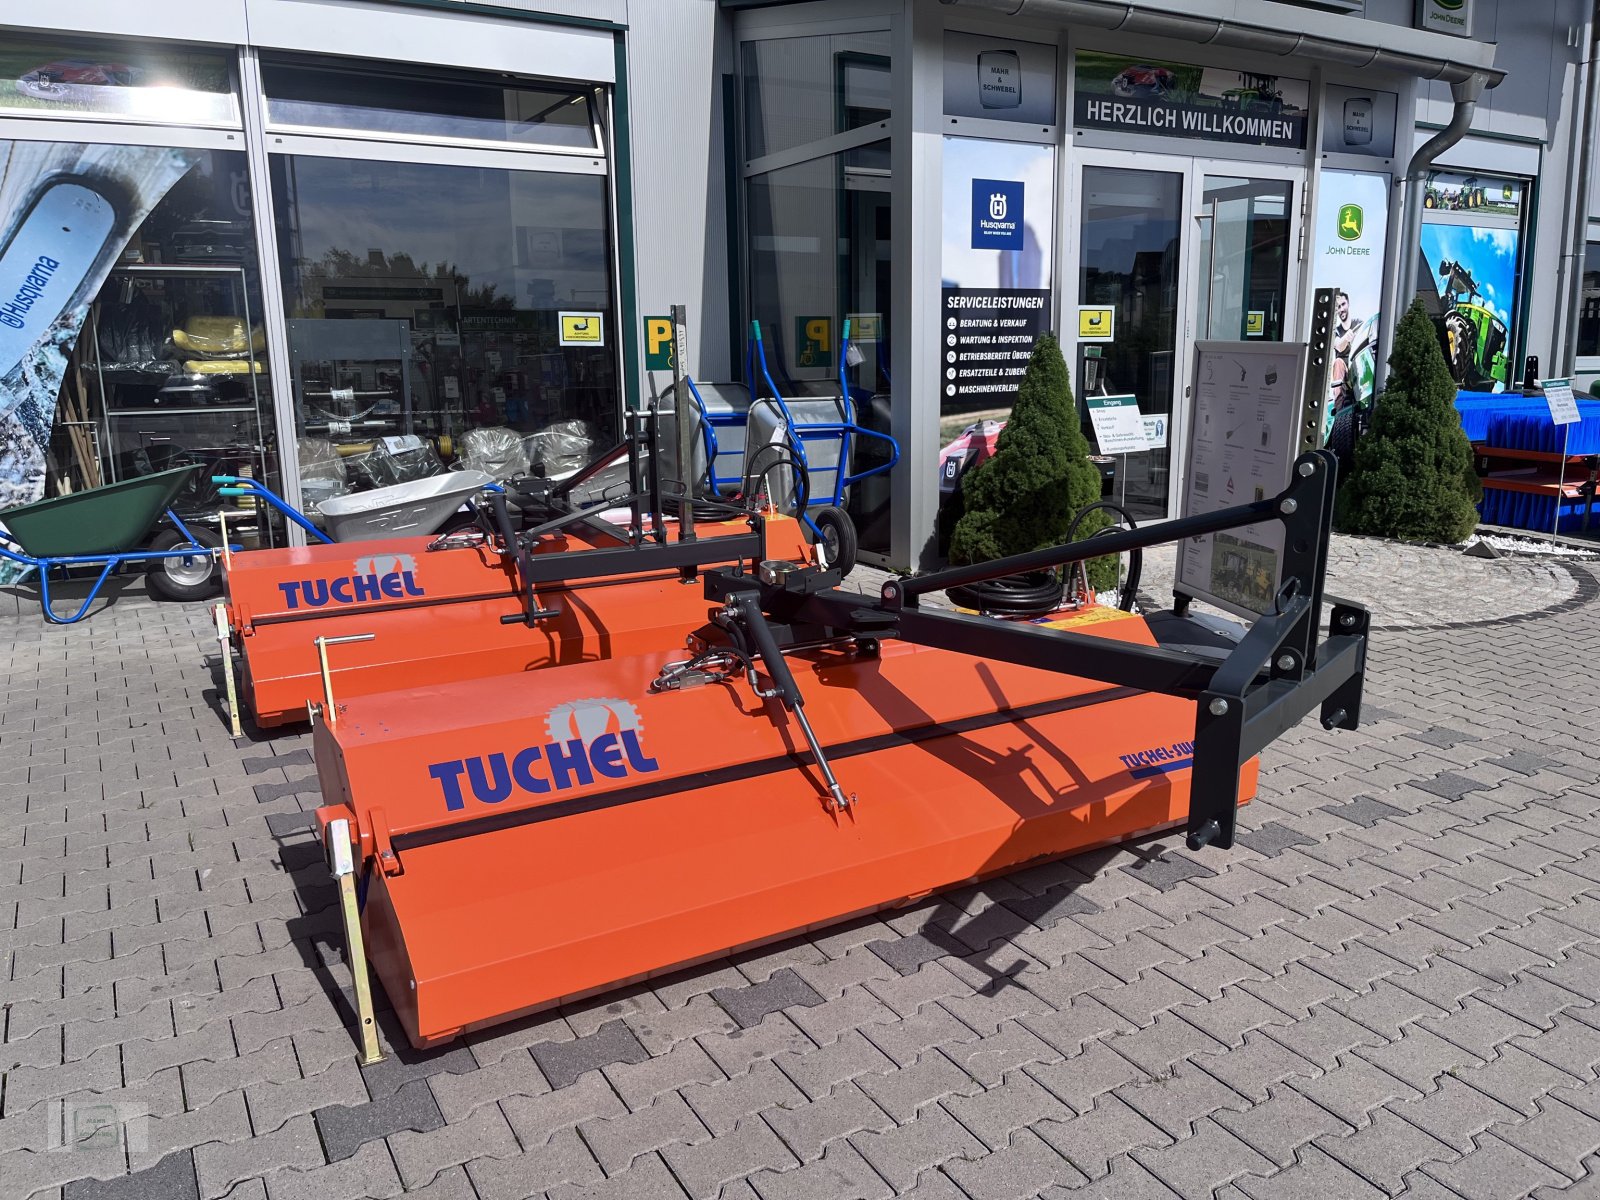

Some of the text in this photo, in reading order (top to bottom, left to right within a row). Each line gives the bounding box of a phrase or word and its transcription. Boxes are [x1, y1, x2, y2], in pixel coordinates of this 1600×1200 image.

[1430, 11, 1465, 26] JOHN DEERE
[990, 66, 1009, 75] MAHR
[983, 83, 1017, 94] SCHWEBEL
[1087, 100, 1293, 140] HERZLICH WILLKOMMEN
[980, 219, 1016, 230] Husqvarna
[1325, 245, 1371, 256] JOHN DEERE
[1, 255, 61, 319] Husqvarna
[947, 296, 1044, 309] SERVICELEISTUNGEN
[960, 319, 1028, 328] BERATUNG & VERKAUF
[960, 335, 1033, 344] WARTUNG & INSPEKTION
[959, 351, 1011, 361] BETRIEBSBEREITE
[959, 368, 998, 377] ERSATZTEILE
[999, 368, 1004, 377] &
[959, 383, 1019, 394] MASCHINENVERLEIH
[278, 570, 425, 609] TUCHEL
[428, 729, 660, 812] TUCHEL
